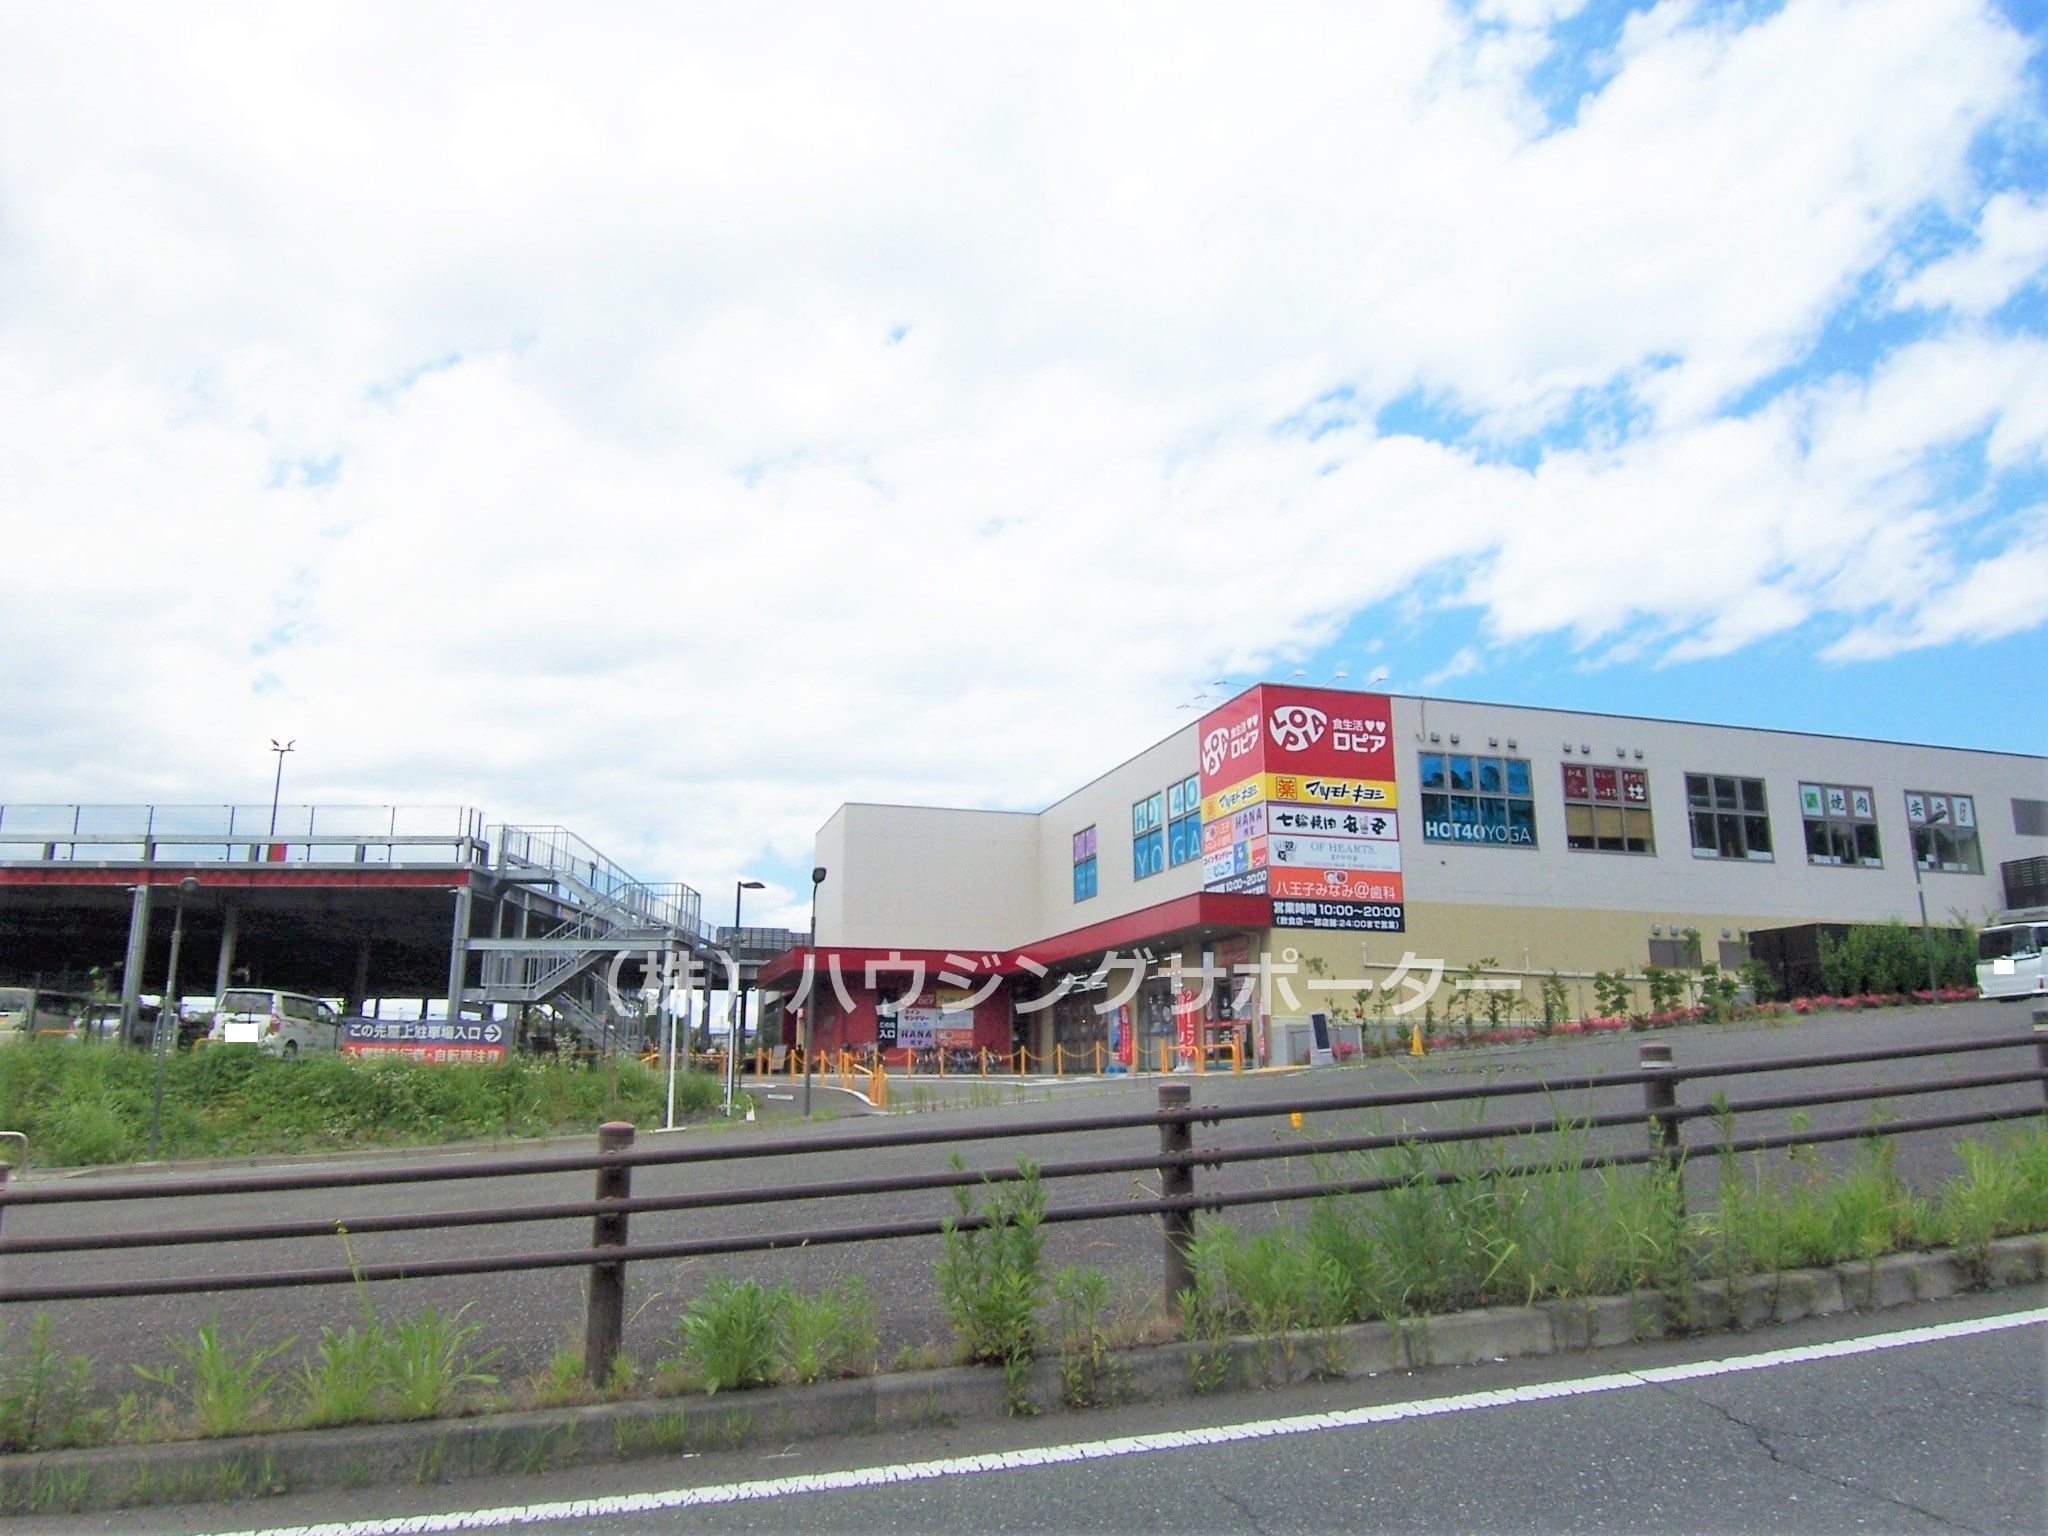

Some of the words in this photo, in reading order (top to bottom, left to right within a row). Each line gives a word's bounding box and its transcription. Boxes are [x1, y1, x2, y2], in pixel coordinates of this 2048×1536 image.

[1332, 718, 1363, 731] 食生活
[1231, 729, 1259, 759] ロピア
[1333, 732, 1386, 753] ロピア
[1173, 780, 1198, 815] 40
[1278, 779, 1295, 798] 薬
[1305, 781, 1385, 803] マツモトキヨシ
[1831, 794, 1868, 813] 焼肉
[1235, 808, 1263, 829] HANA
[1137, 830, 1201, 878] YOGA
[1310, 842, 1325, 852] OF
[1276, 880, 1395, 900] 八王子みなみ@歯科
[1273, 901, 1317, 915] 営業時間
[350, 1024, 481, 1040] この先屋上駐車場入口
[879, 1029, 896, 1039] 入口
[901, 1030, 932, 1038] HANA
